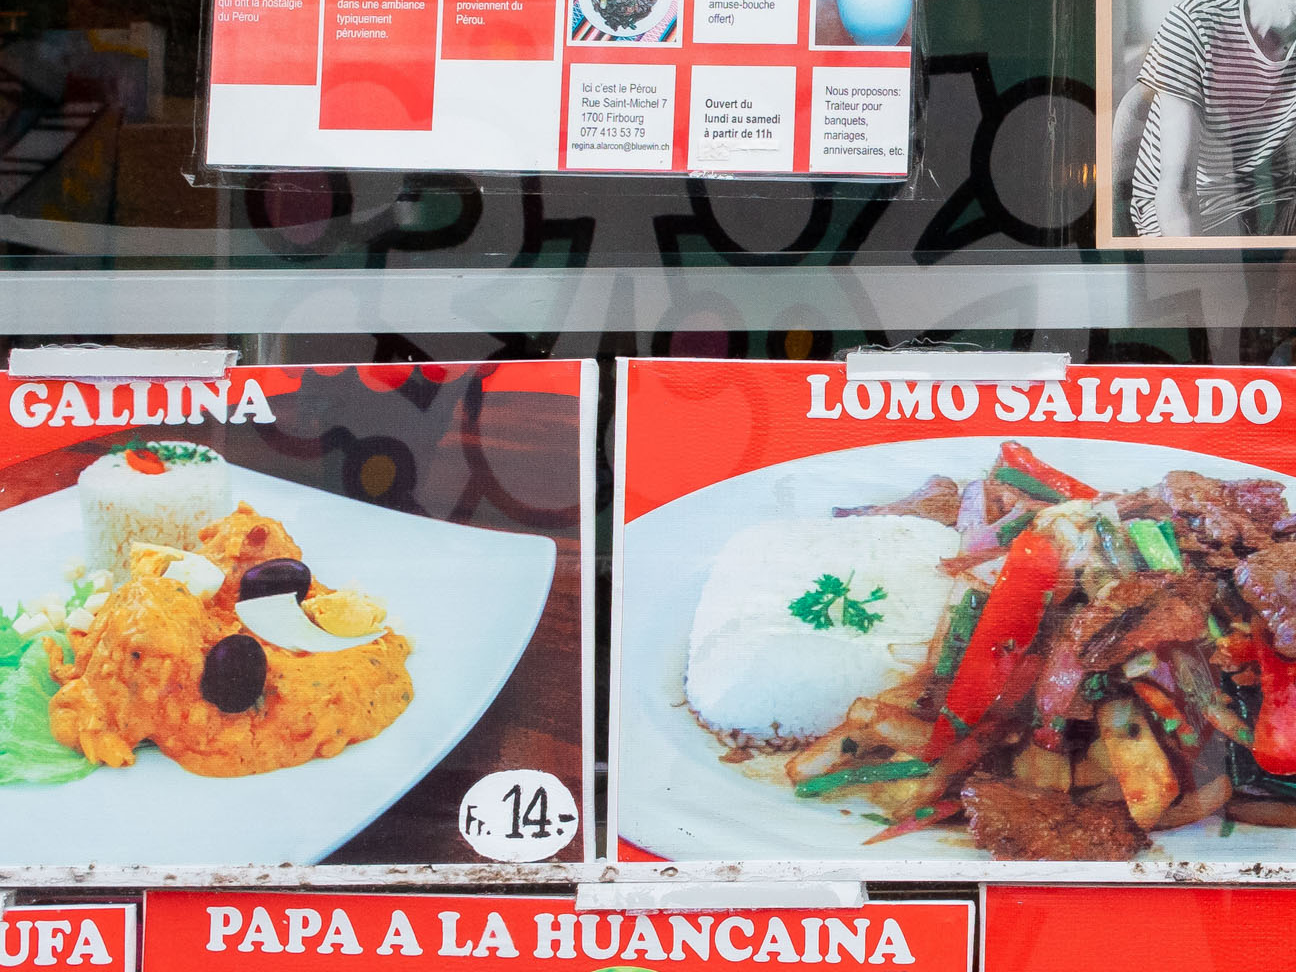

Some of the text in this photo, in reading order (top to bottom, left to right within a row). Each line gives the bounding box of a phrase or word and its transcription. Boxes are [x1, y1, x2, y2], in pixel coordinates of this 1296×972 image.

[362, 0, 379, 8] une
[457, 0, 522, 12] proviennent du
[709, 0, 774, 9] amuse-bouche
[218, 10, 259, 21] du Pérou
[337, 13, 392, 25] typiquement
[456, 13, 485, 24] Pérou.
[708, 13, 735, 25] offert)
[336, 27, 388, 39] péruvienne.
[582, 83, 592, 92] Ici
[619, 83, 627, 92] le
[630, 83, 656, 94] Pérou
[826, 85, 901, 98] Nous proposons:
[582, 97, 666, 108] Rue Saint-Michel 7
[705, 98, 752, 108] Ouvert du
[825, 100, 882, 113] Traiteur pour
[582, 111, 644, 125] 1700 Firbourg
[705, 112, 780, 123] lundi au samedi
[825, 114, 868, 127] banquets,
[580, 126, 645, 136] 077 413 53 79
[704, 127, 772, 140] à partir de 11h
[824, 130, 867, 142] mariages,
[572, 140, 669, 152] regina.alarcon@bluewin.ch
[823, 144, 886, 156] anniversaires,
[9, 379, 275, 428] GALLINA
[806, 374, 1282, 424] LOMO SALTADO
[465, 806, 489, 836] Fr.
[207, 906, 916, 966] PAPA A LA HUANCAINA
